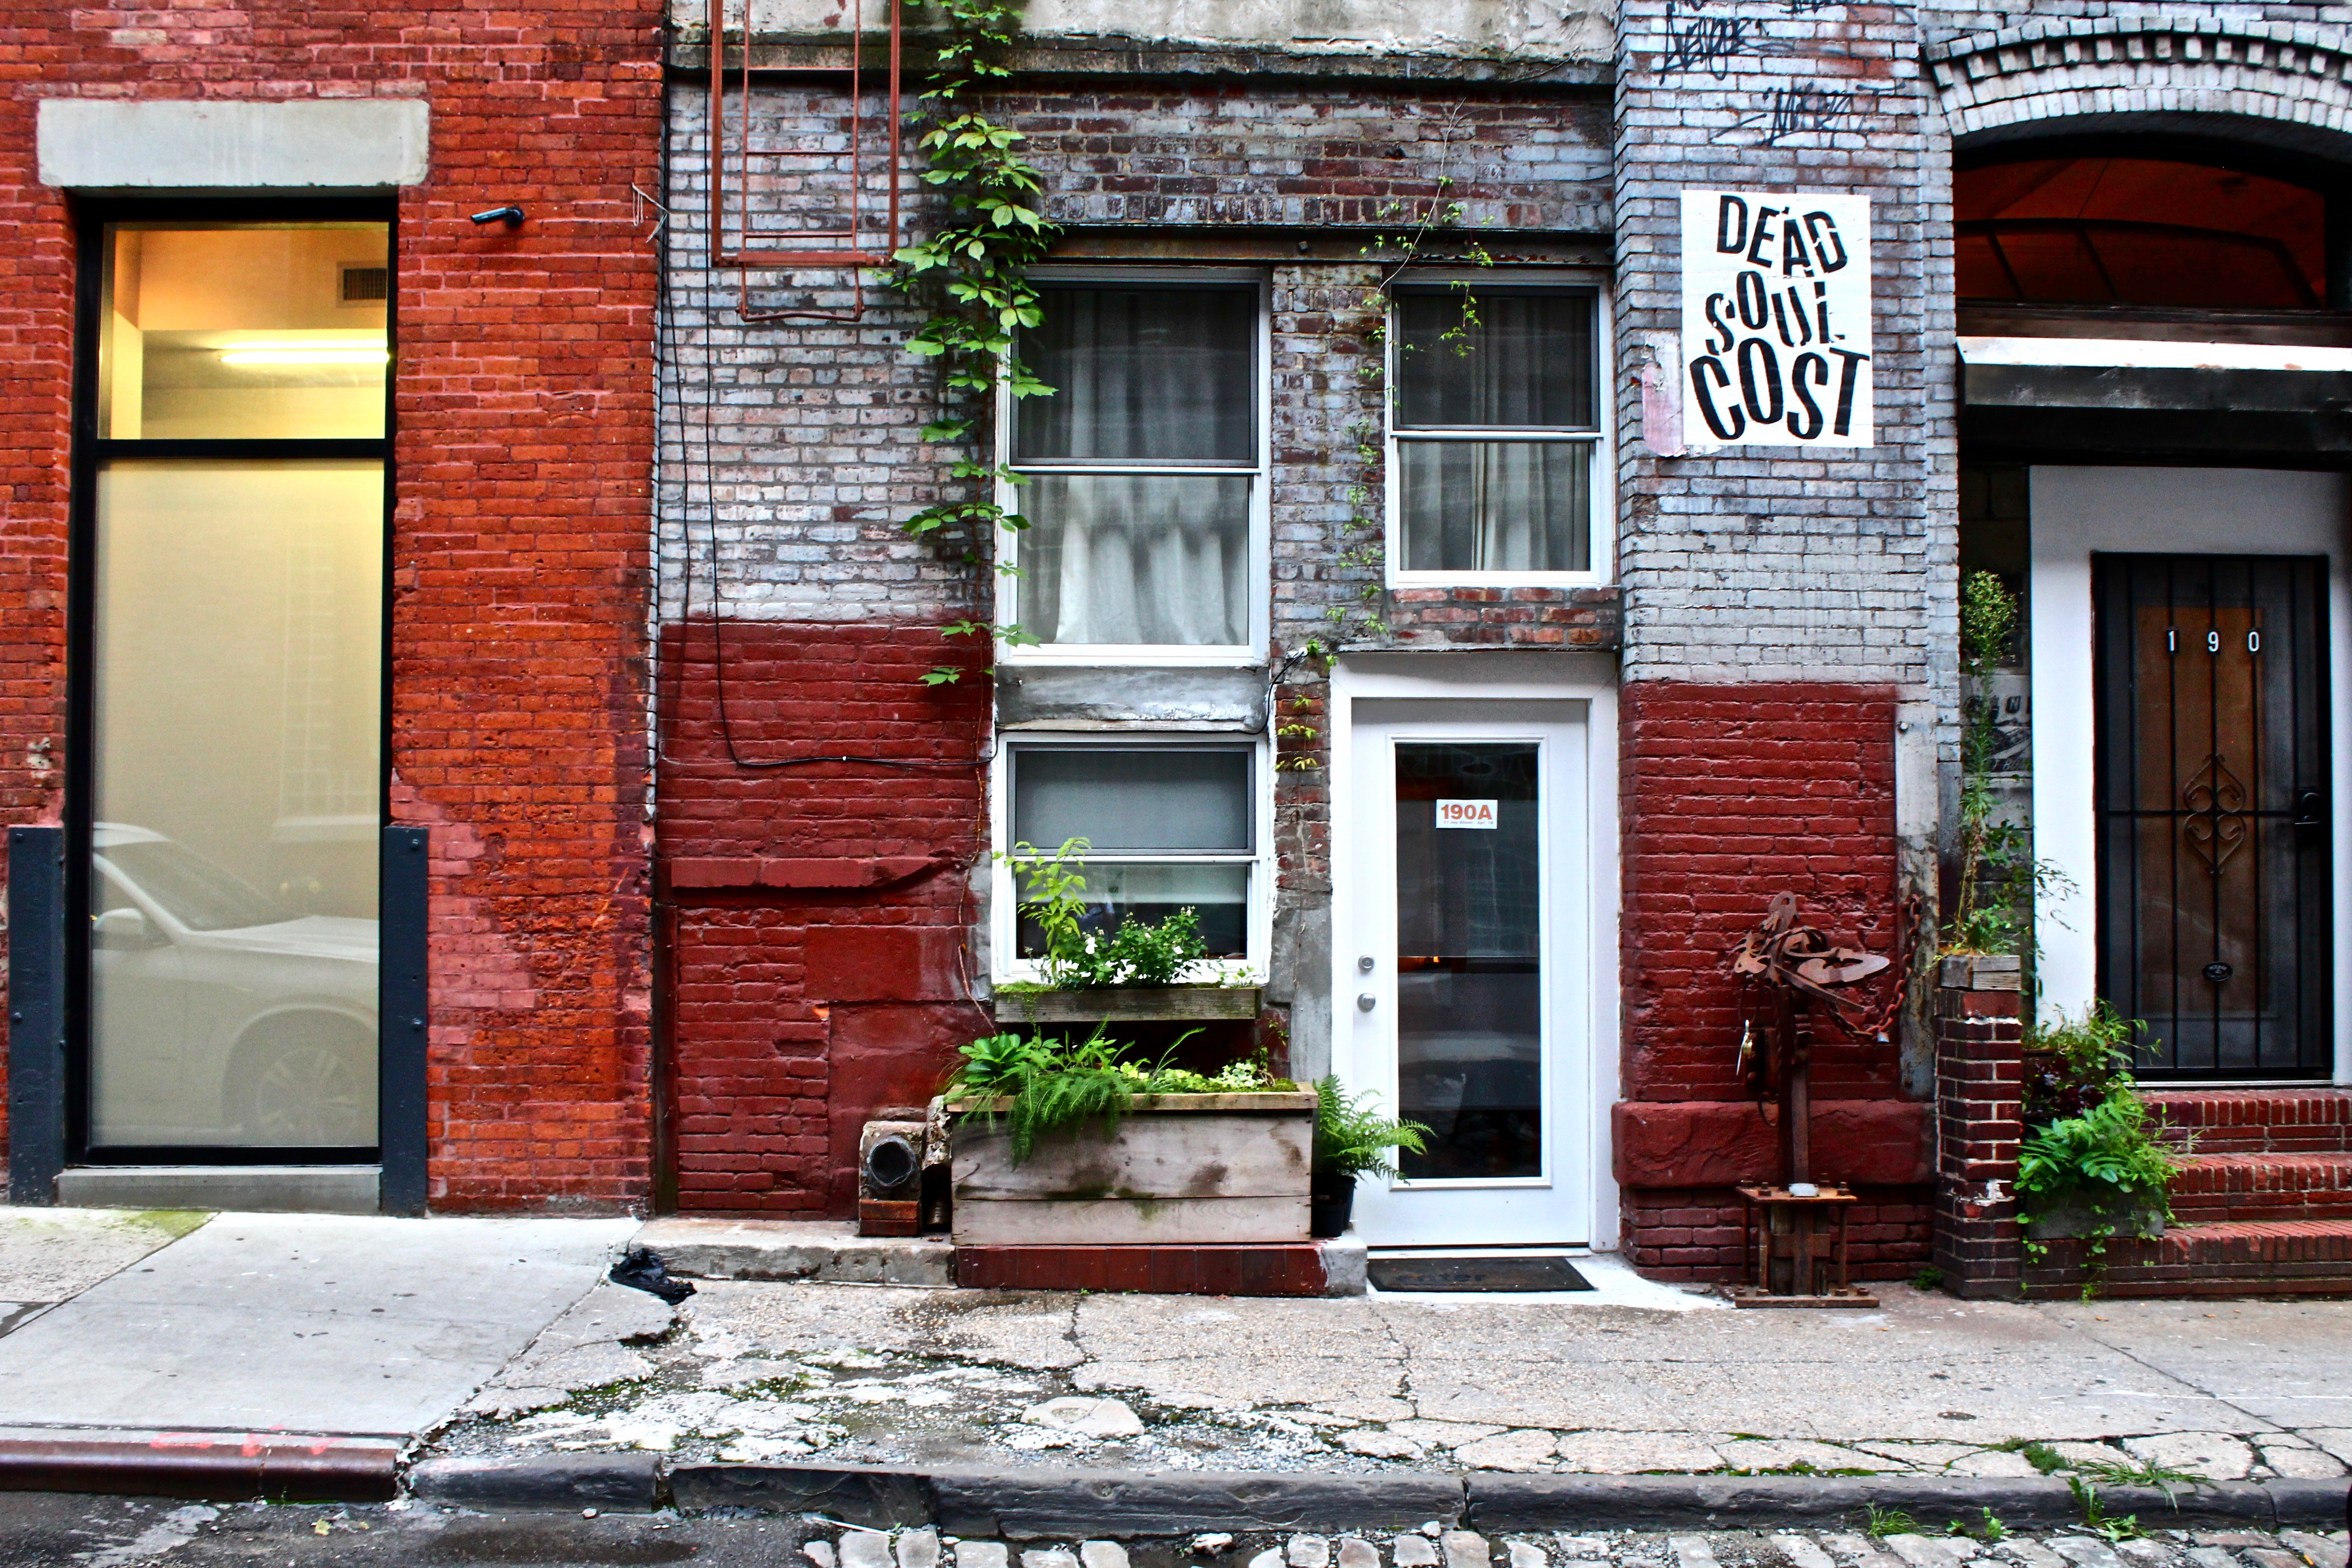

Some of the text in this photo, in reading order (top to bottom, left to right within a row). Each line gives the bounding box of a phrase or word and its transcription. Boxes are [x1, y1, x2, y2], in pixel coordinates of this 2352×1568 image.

[1716, 195, 1847, 277] DEAD
[1705, 270, 1845, 355] SOUL
[1689, 338, 1870, 440] COST
[2168, 630, 2260, 652] 190
[1441, 804, 1492, 820] 190A
